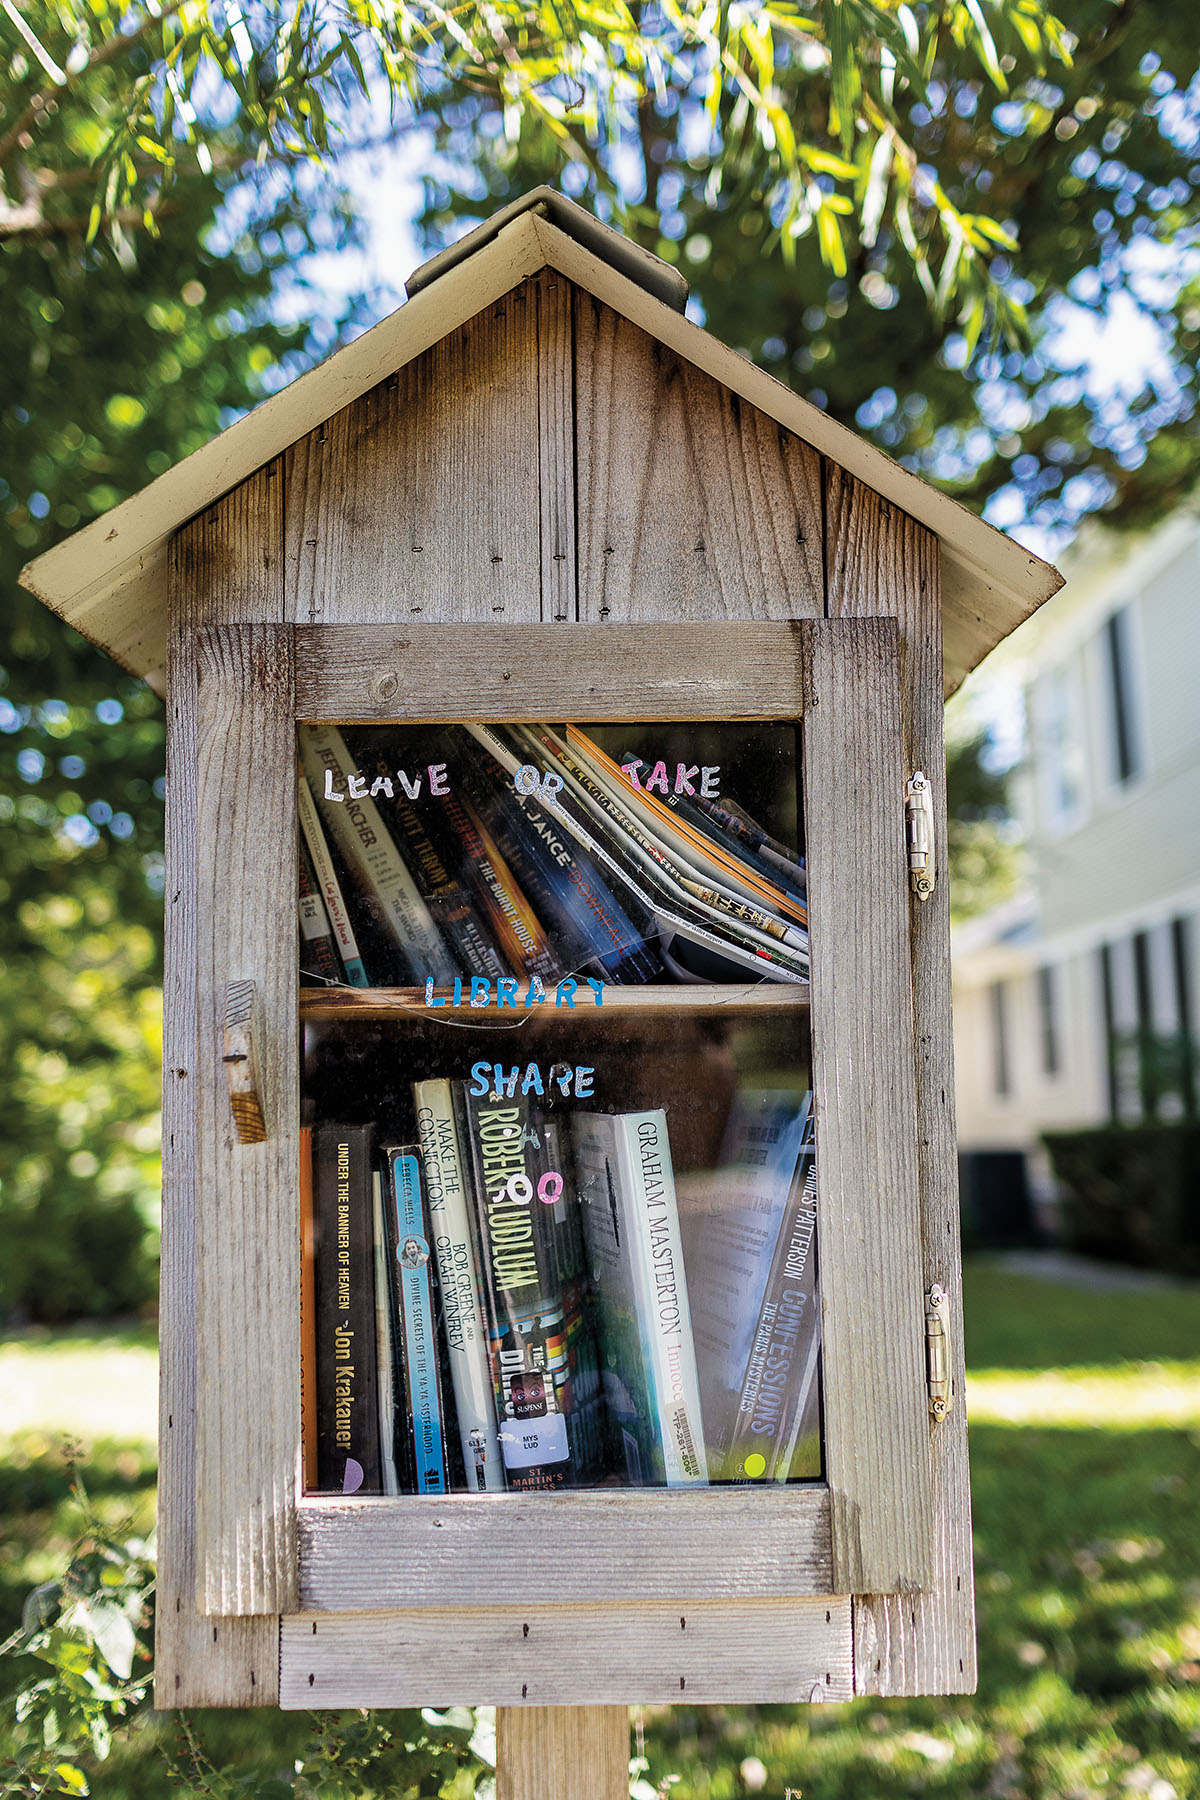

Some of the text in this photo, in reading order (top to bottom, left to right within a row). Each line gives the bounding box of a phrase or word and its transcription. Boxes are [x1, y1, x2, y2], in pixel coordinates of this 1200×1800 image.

[482, 727, 508, 754] OCTOBER 2021
[324, 763, 451, 802] LEAVE
[621, 760, 721, 798] TAKE
[414, 839, 449, 884] TUROW
[526, 812, 572, 867] JANCE
[479, 861, 497, 882] THE
[490, 882, 518, 918] BURNT
[510, 918, 538, 954] HOUSE
[568, 869, 629, 956] DOWNFALL
[462, 936, 486, 973] ERRORS
[466, 922, 500, 978] REVERSIBLE
[425, 975, 605, 1009] LIBRARY
[401, 1163, 415, 1225] REBECCA WELLS
[417, 1107, 446, 1212] CONNECTION
[436, 1118, 460, 1195] MAKE THE
[637, 1121, 667, 1209] GRAHAM
[337, 1143, 350, 1310] UNDER THE BANNER OF HEAVEN
[487, 1202, 539, 1292] LUDLUM
[783, 1164, 817, 1280] JAMES PATTERSON
[436, 1235, 465, 1353] OPRAH WINFREY
[452, 1243, 476, 1341] BOB GREENE AND
[648, 1215, 682, 1336] MASTERTON
[334, 1325, 355, 1450] Jon Krakauer
[410, 1277, 433, 1455] DIVINE SECRETS OF THE YA-YA SISTERHOOD
[532, 1345, 545, 1367] THE
[740, 1301, 778, 1414] THE PARIS MYSTERIES
[750, 1289, 807, 1437] CONFESSIONS
[516, 1401, 544, 1414] SUSPENSE
[522, 1434, 539, 1443] MYS
[523, 1441, 539, 1450] LUD
[512, 1473, 564, 1487] MARTIN'S
[528, 1468, 546, 1477] ST.
